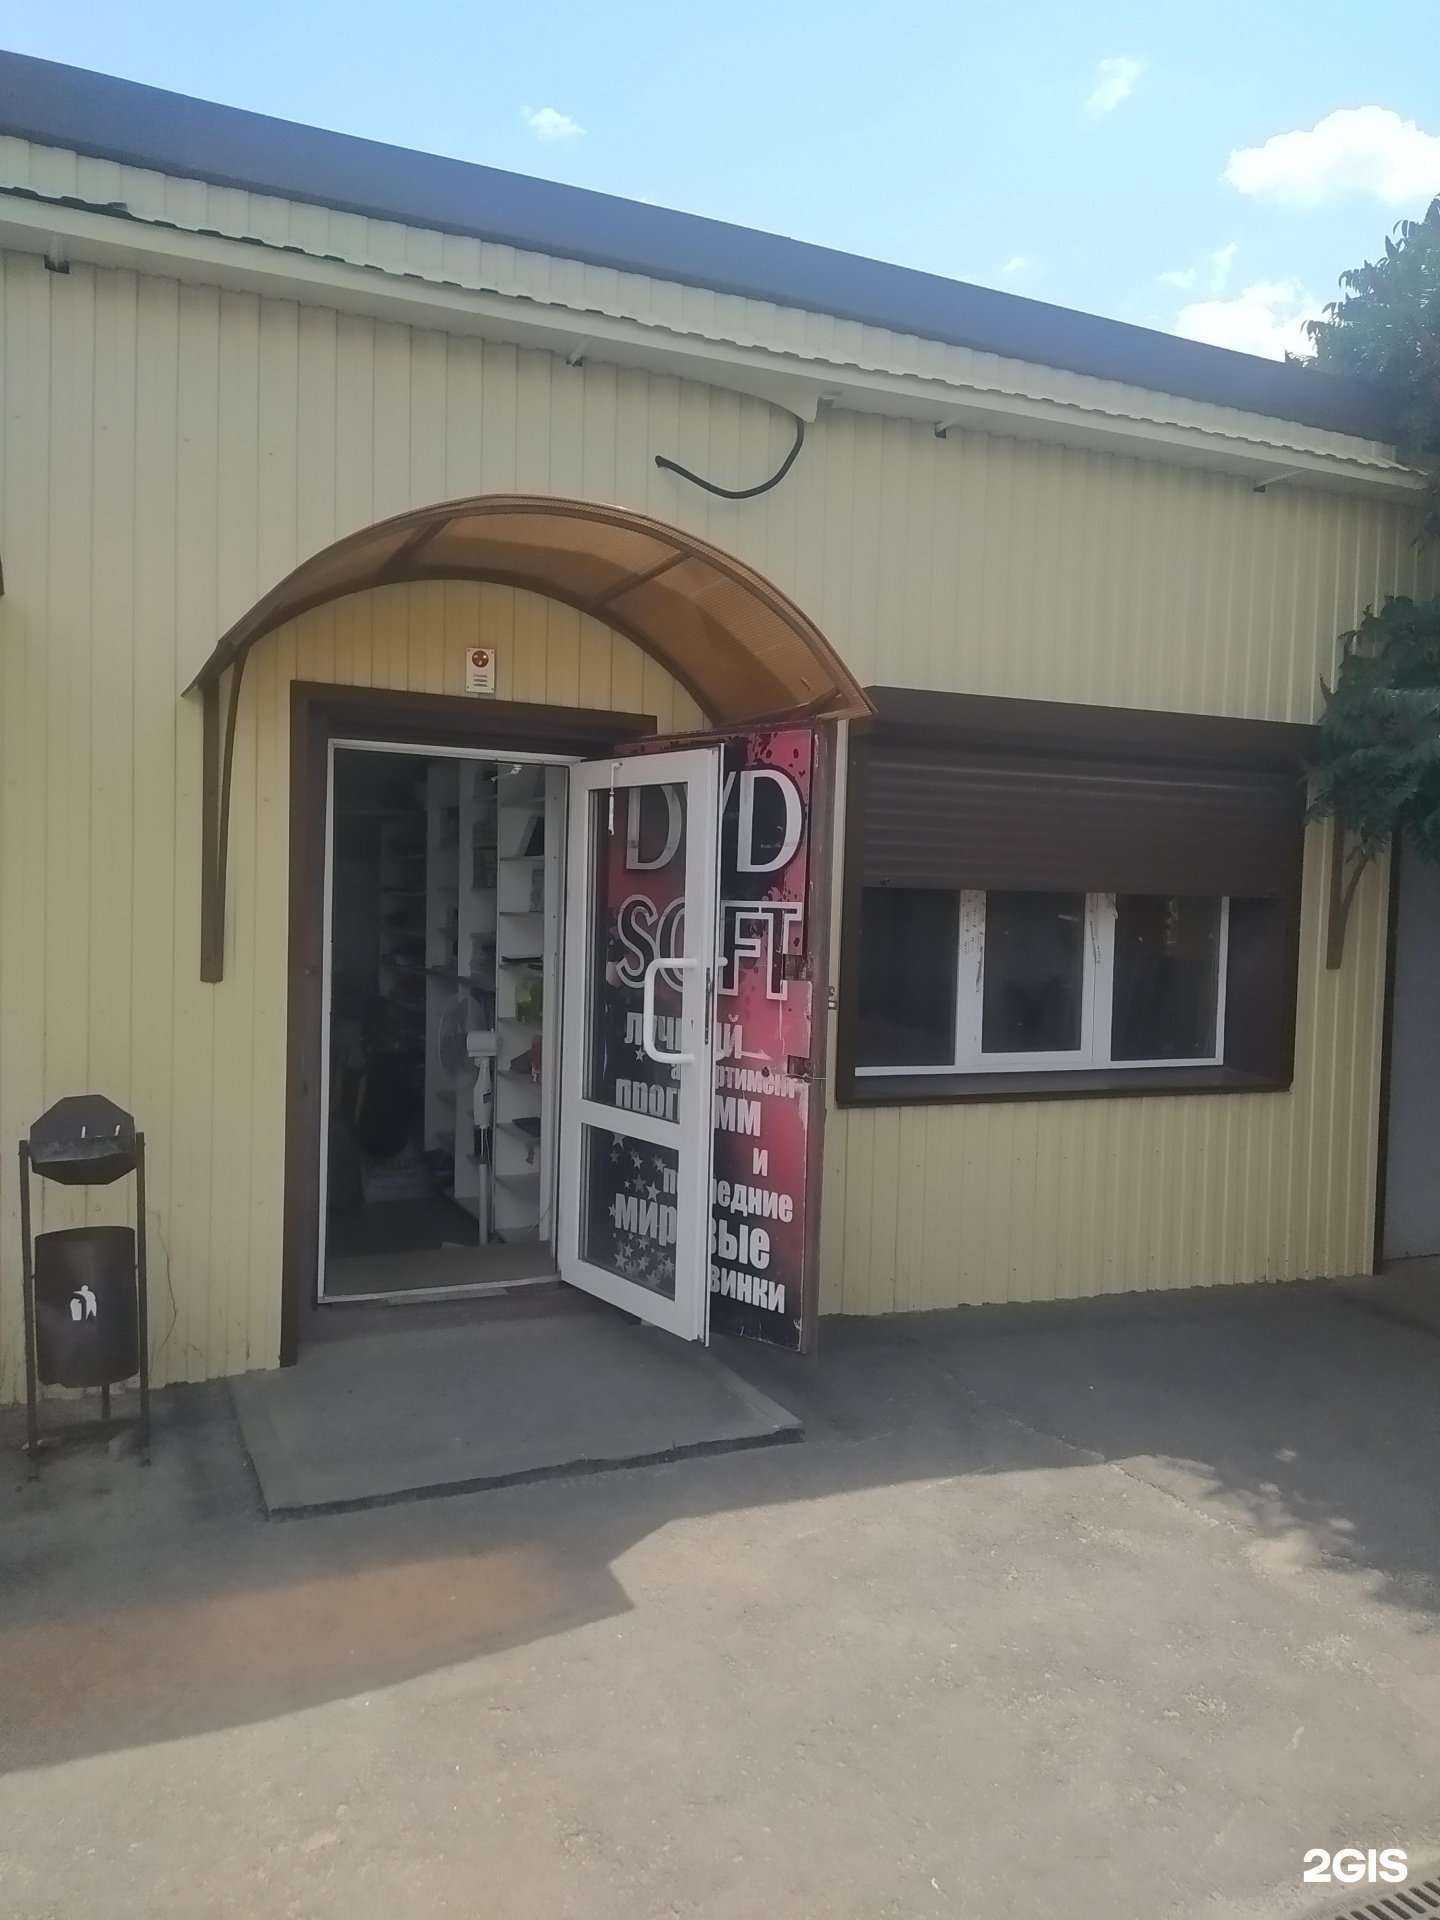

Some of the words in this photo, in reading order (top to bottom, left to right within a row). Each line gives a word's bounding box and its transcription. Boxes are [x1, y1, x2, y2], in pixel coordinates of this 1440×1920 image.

[615, 1078, 761, 1137] прогмм
[752, 1147, 768, 1177] и
[663, 1167, 794, 1223] педние
[614, 1192, 770, 1270] мирые
[711, 1264, 786, 1314] винки
